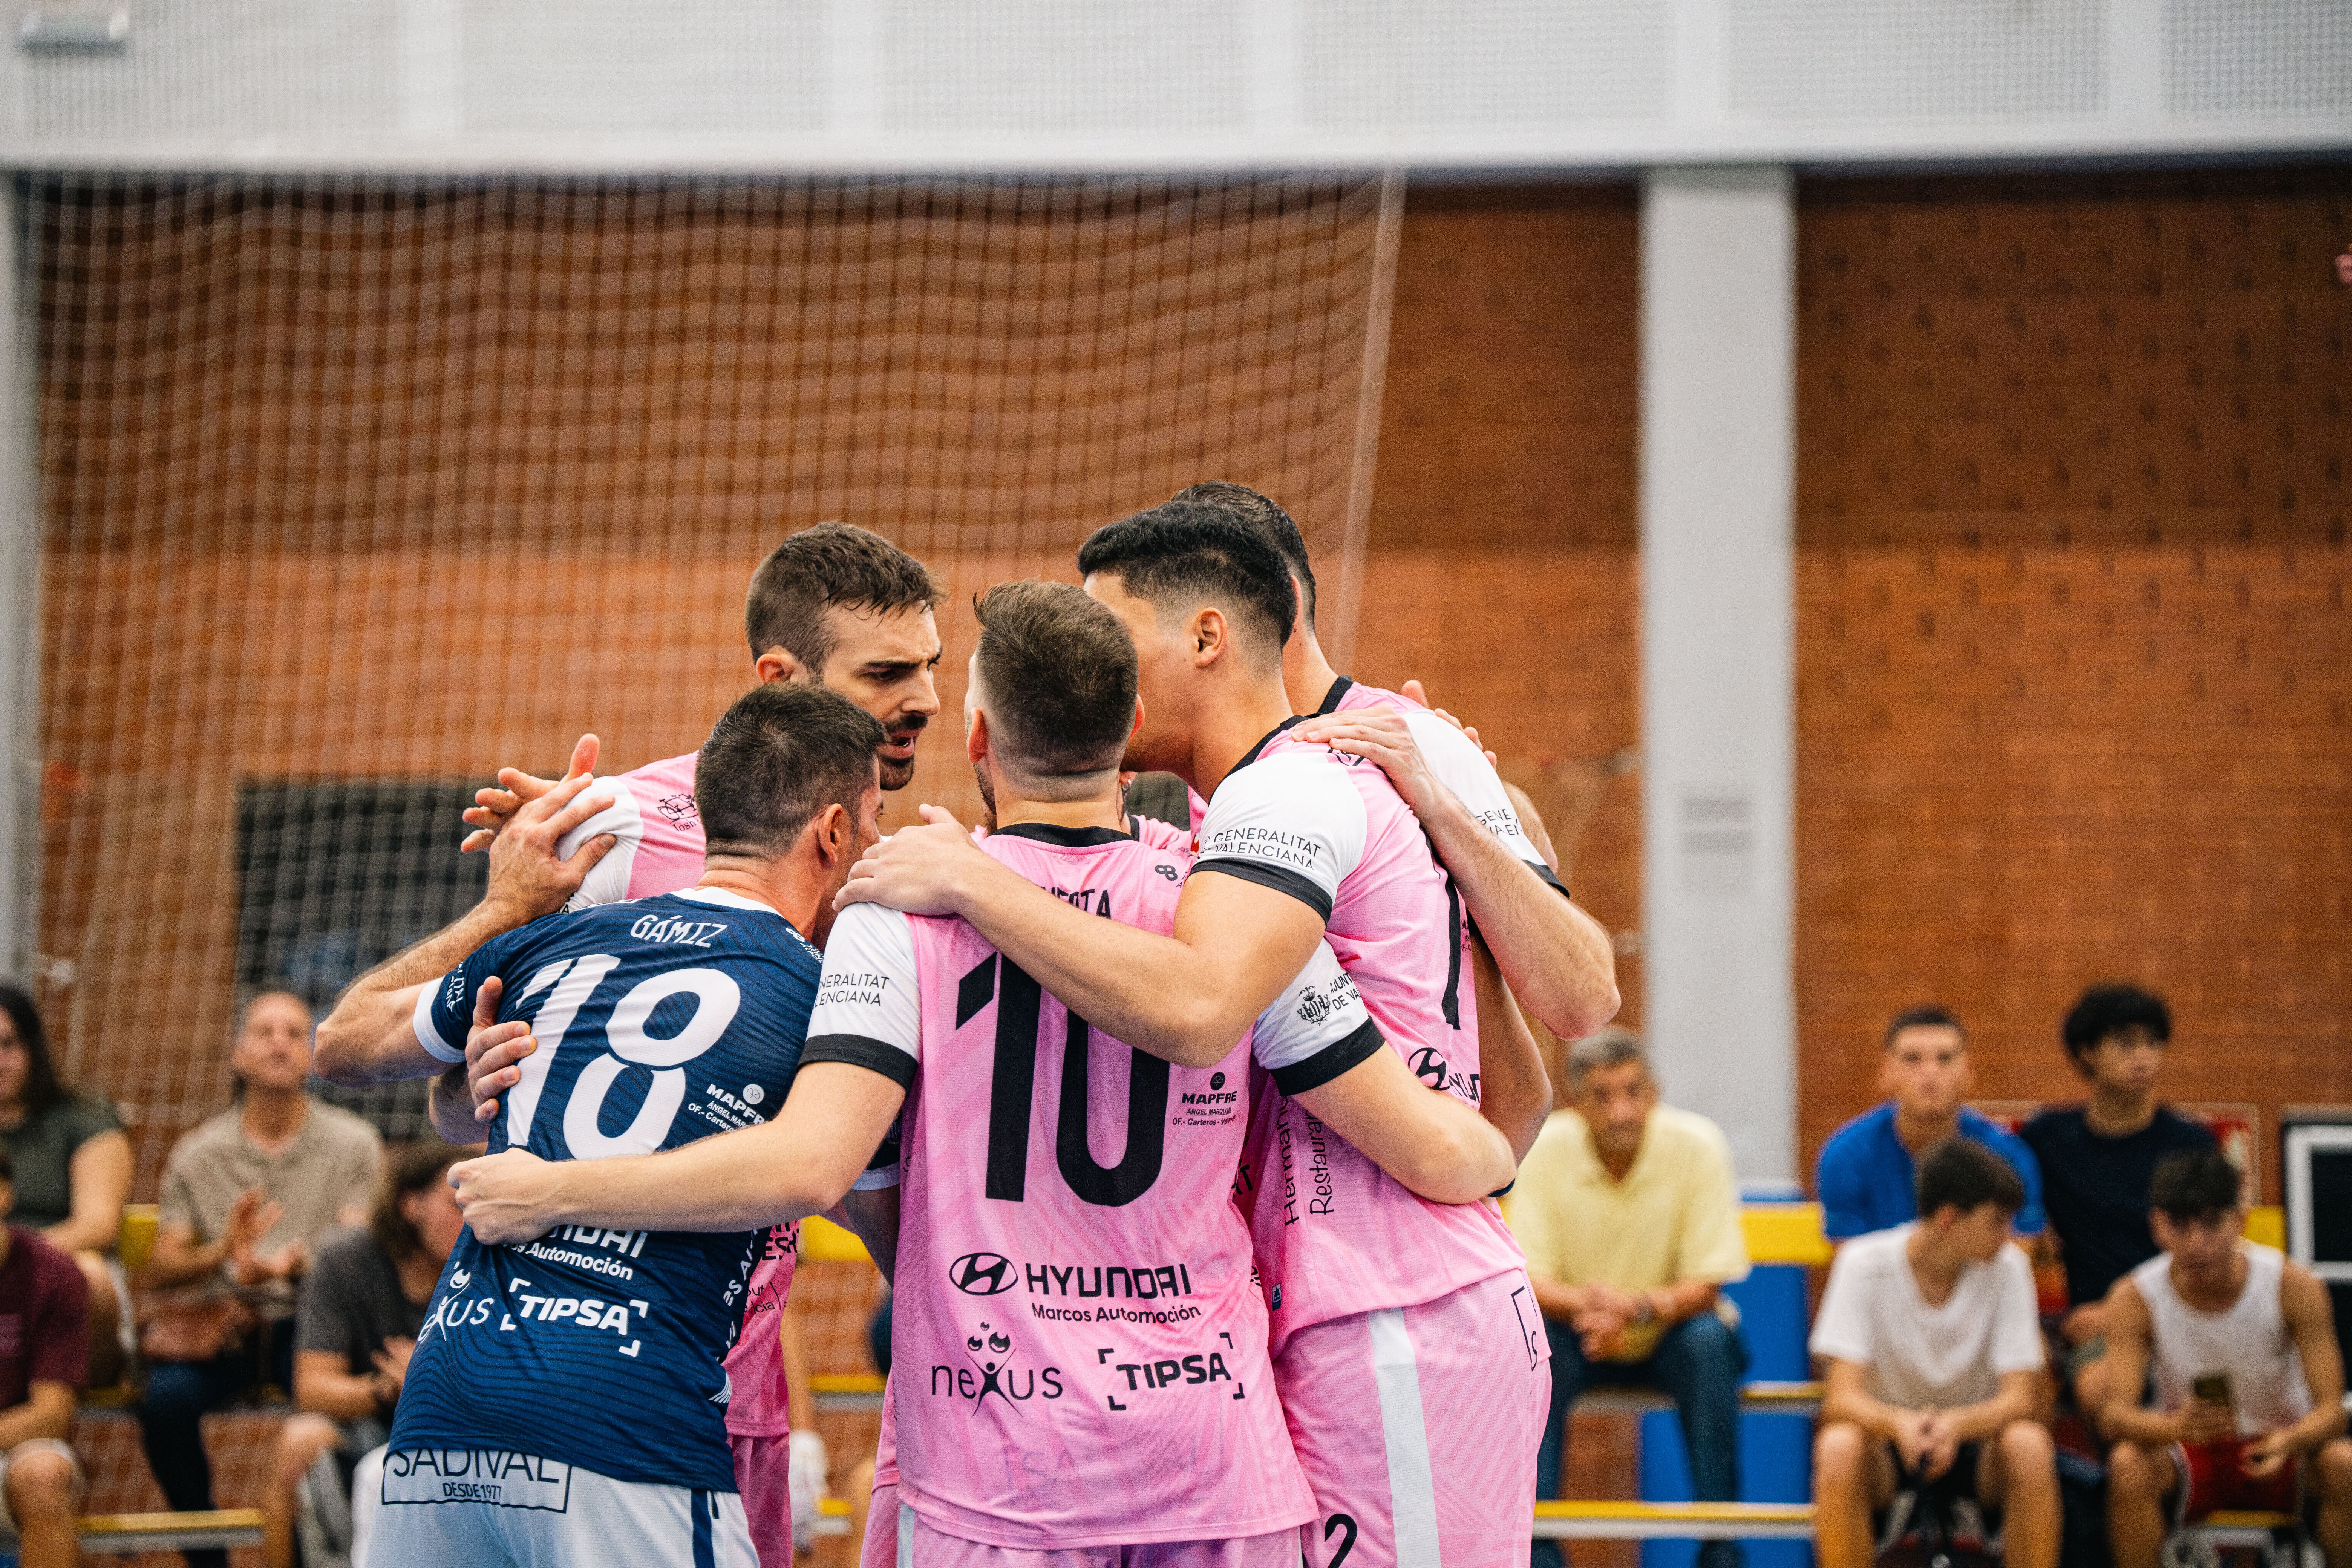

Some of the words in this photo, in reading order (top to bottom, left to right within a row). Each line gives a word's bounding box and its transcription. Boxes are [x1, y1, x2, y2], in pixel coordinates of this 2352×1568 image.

[1214, 828, 1321, 857] GENERALITAT
[1215, 841, 1315, 871] VALENCIANA
[630, 914, 728, 948] GÁMIZ
[1332, 995, 1349, 1011] DE
[507, 952, 740, 1160] 18
[956, 951, 1170, 1207] 10
[707, 1101, 730, 1119] ÁNGEL
[1181, 1091, 1237, 1104] MAPFRE
[1187, 1118, 1216, 1126] Carteros
[525, 1242, 634, 1280] Automoción
[1026, 1263, 1192, 1299] HYUNDAI
[519, 1294, 629, 1336] TIPSA
[1031, 1302, 1092, 1322] Marcos
[1096, 1304, 1201, 1324] Automoción
[1116, 1352, 1231, 1391] TIPSA
